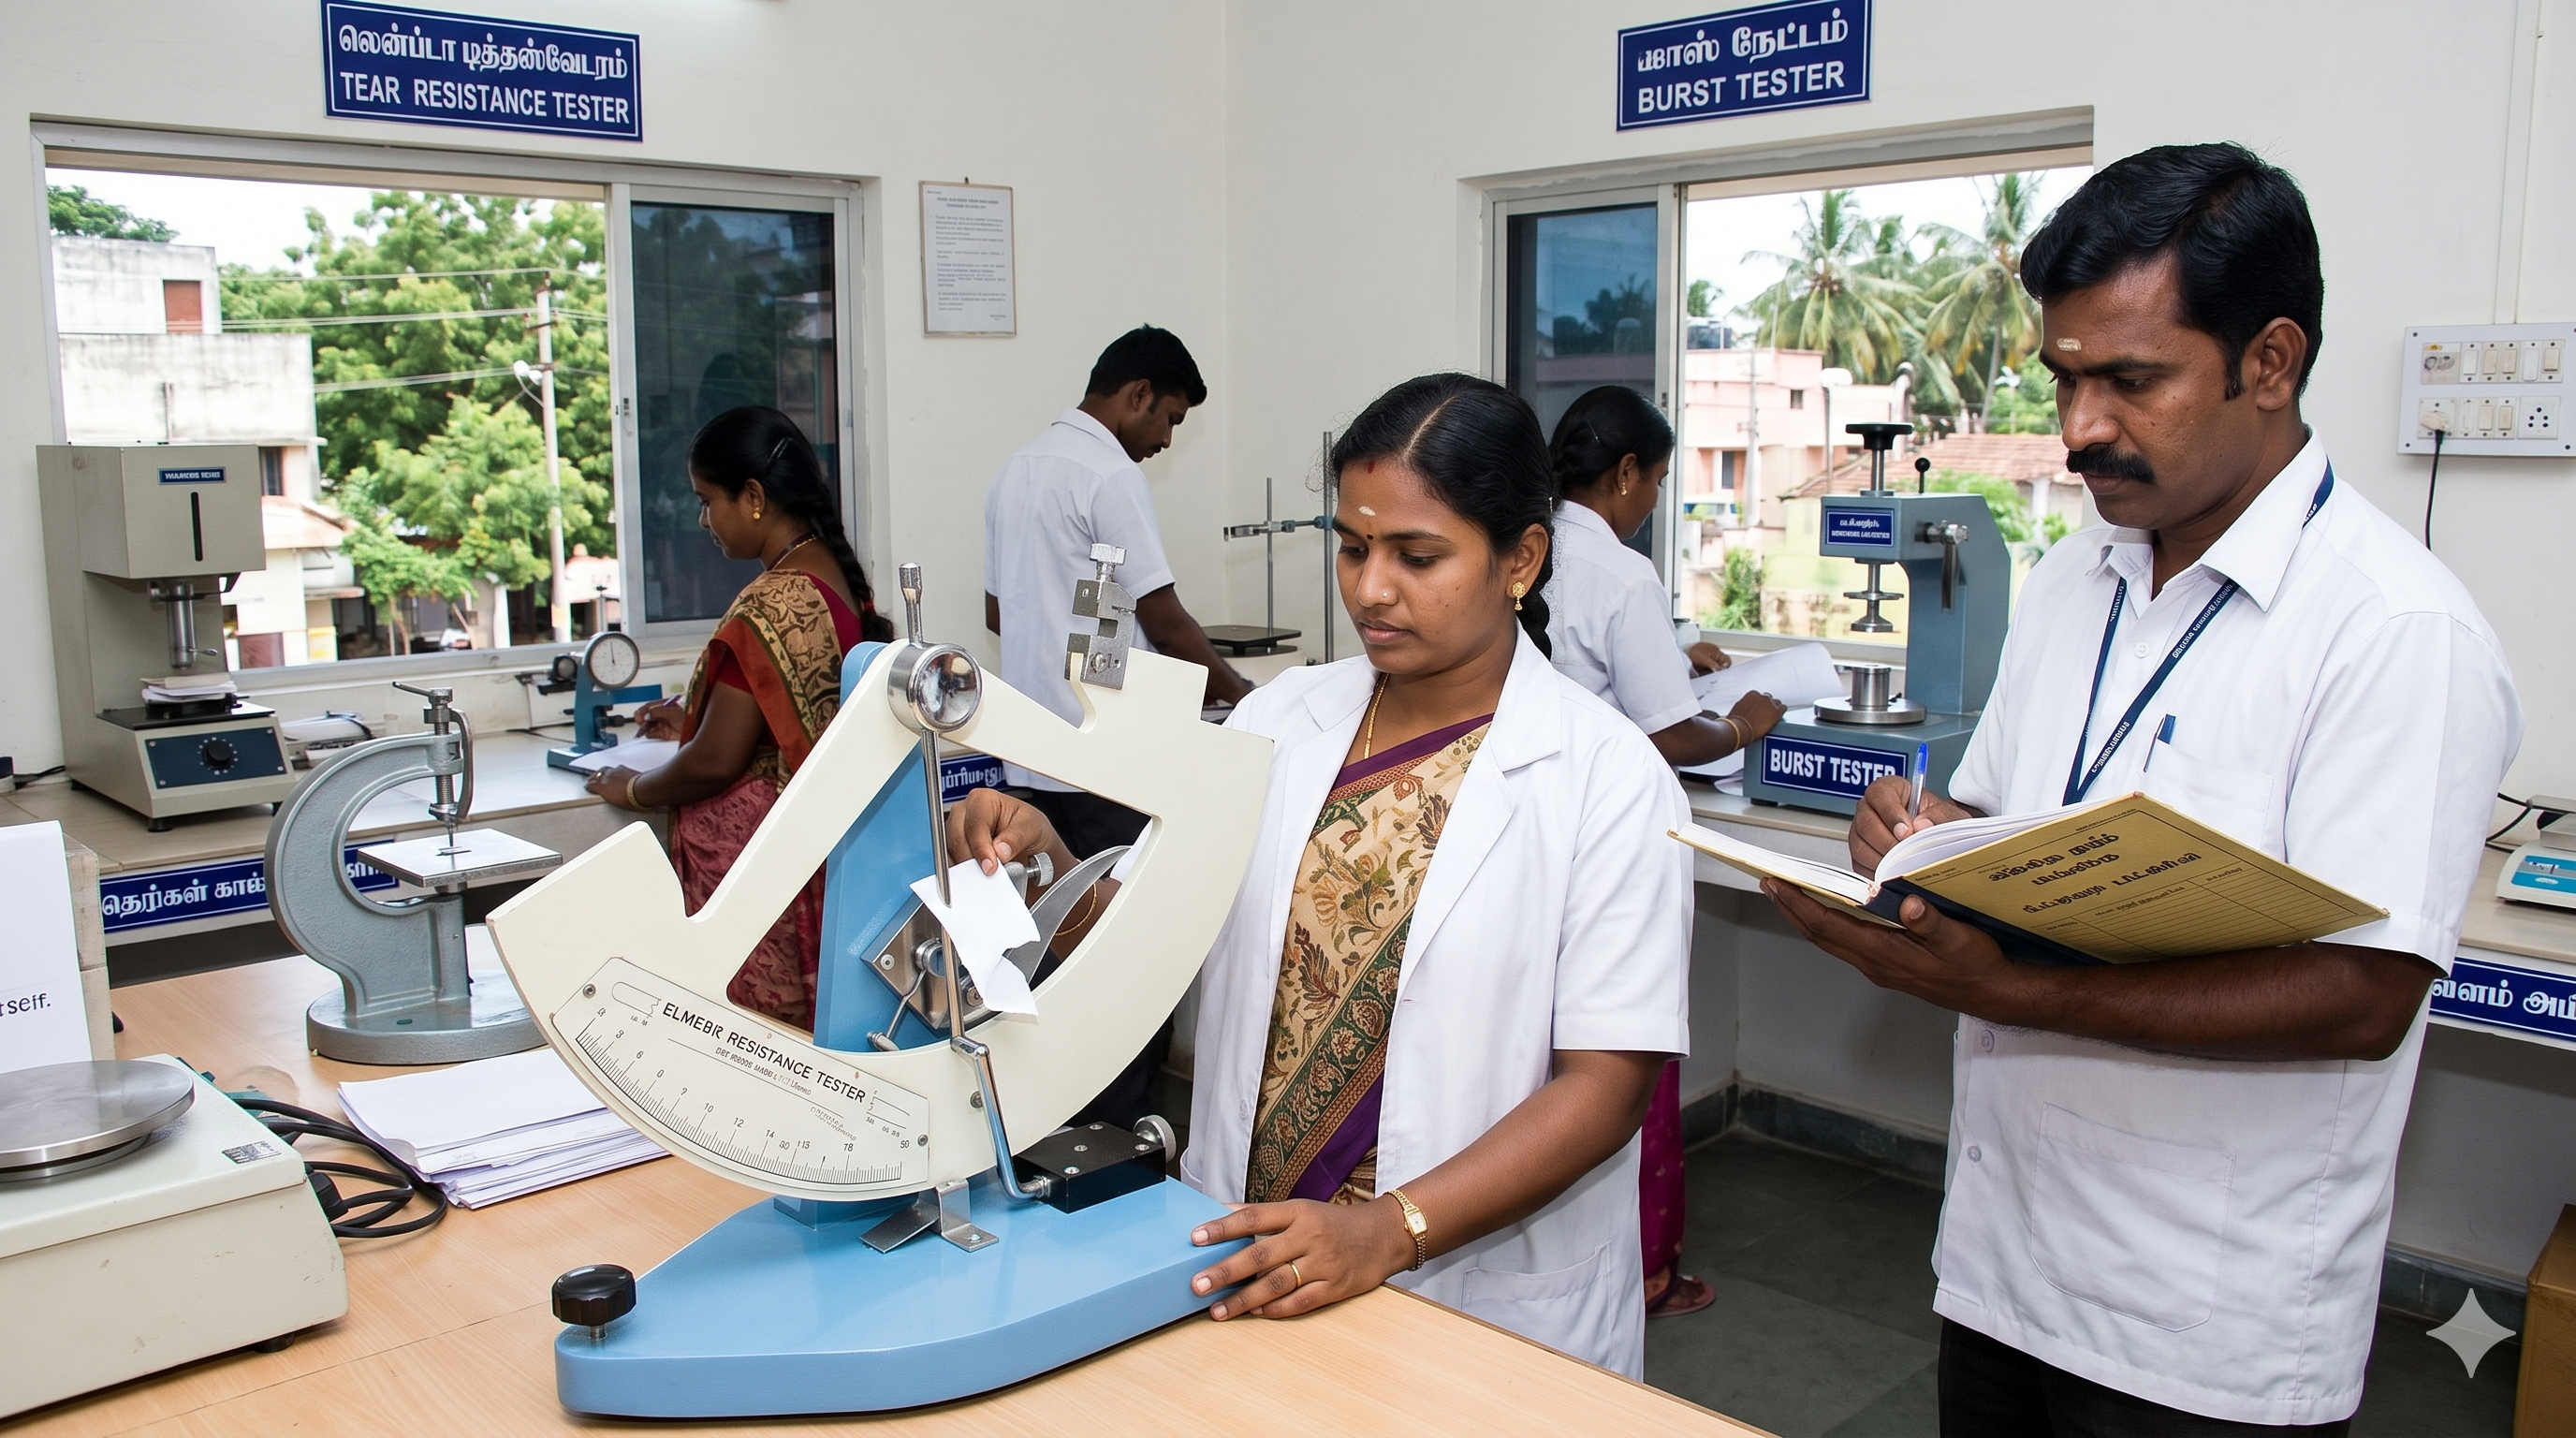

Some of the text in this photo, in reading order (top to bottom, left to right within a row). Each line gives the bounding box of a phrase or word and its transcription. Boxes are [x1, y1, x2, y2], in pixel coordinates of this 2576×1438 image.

[340, 71, 629, 124] TEAR RESISTANCE TESTER
[1638, 61, 1845, 113] BURST TESTER
[1770, 748, 1825, 779] BURST
[726, 1032, 813, 1079] RESISTANCE
[816, 1071, 866, 1103] TESTER
[704, 1102, 714, 1113] 10
[733, 1117, 745, 1128] 12
